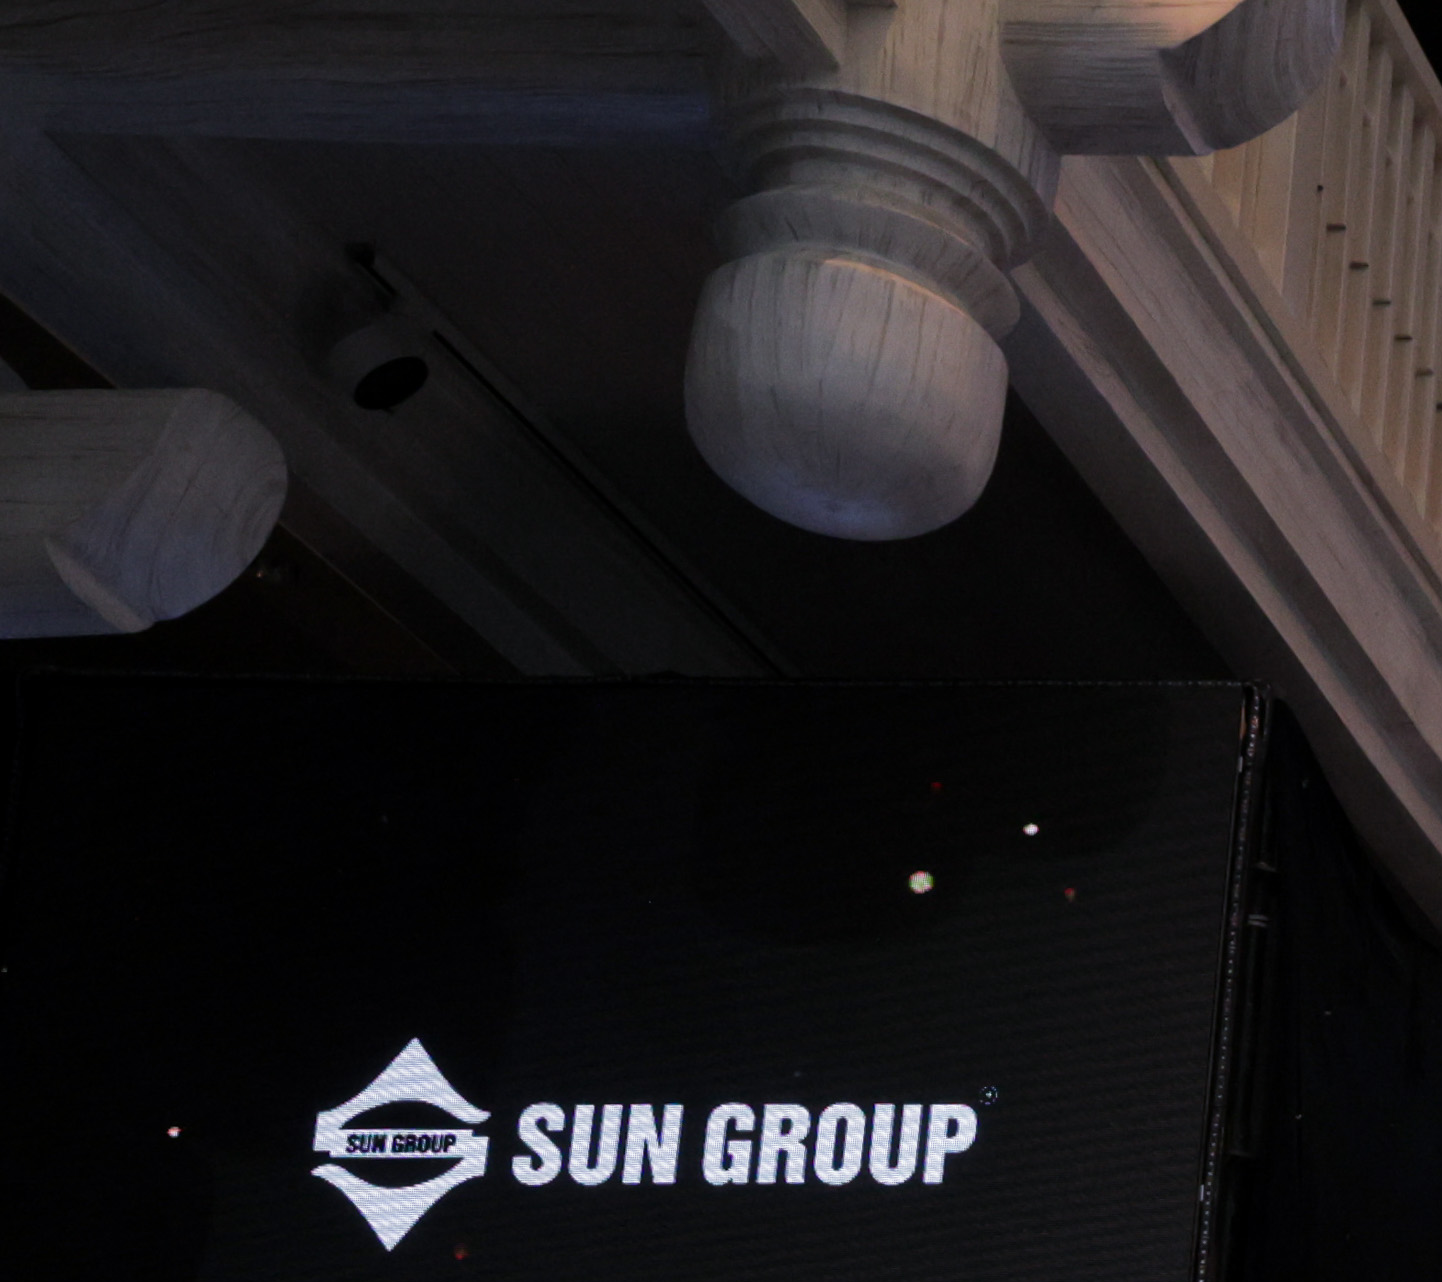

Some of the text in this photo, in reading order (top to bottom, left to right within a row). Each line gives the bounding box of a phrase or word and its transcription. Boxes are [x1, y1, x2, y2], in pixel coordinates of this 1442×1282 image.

[346, 1133, 457, 1154] SUN GROUP
[511, 1102, 977, 1186] SUN GROUP
